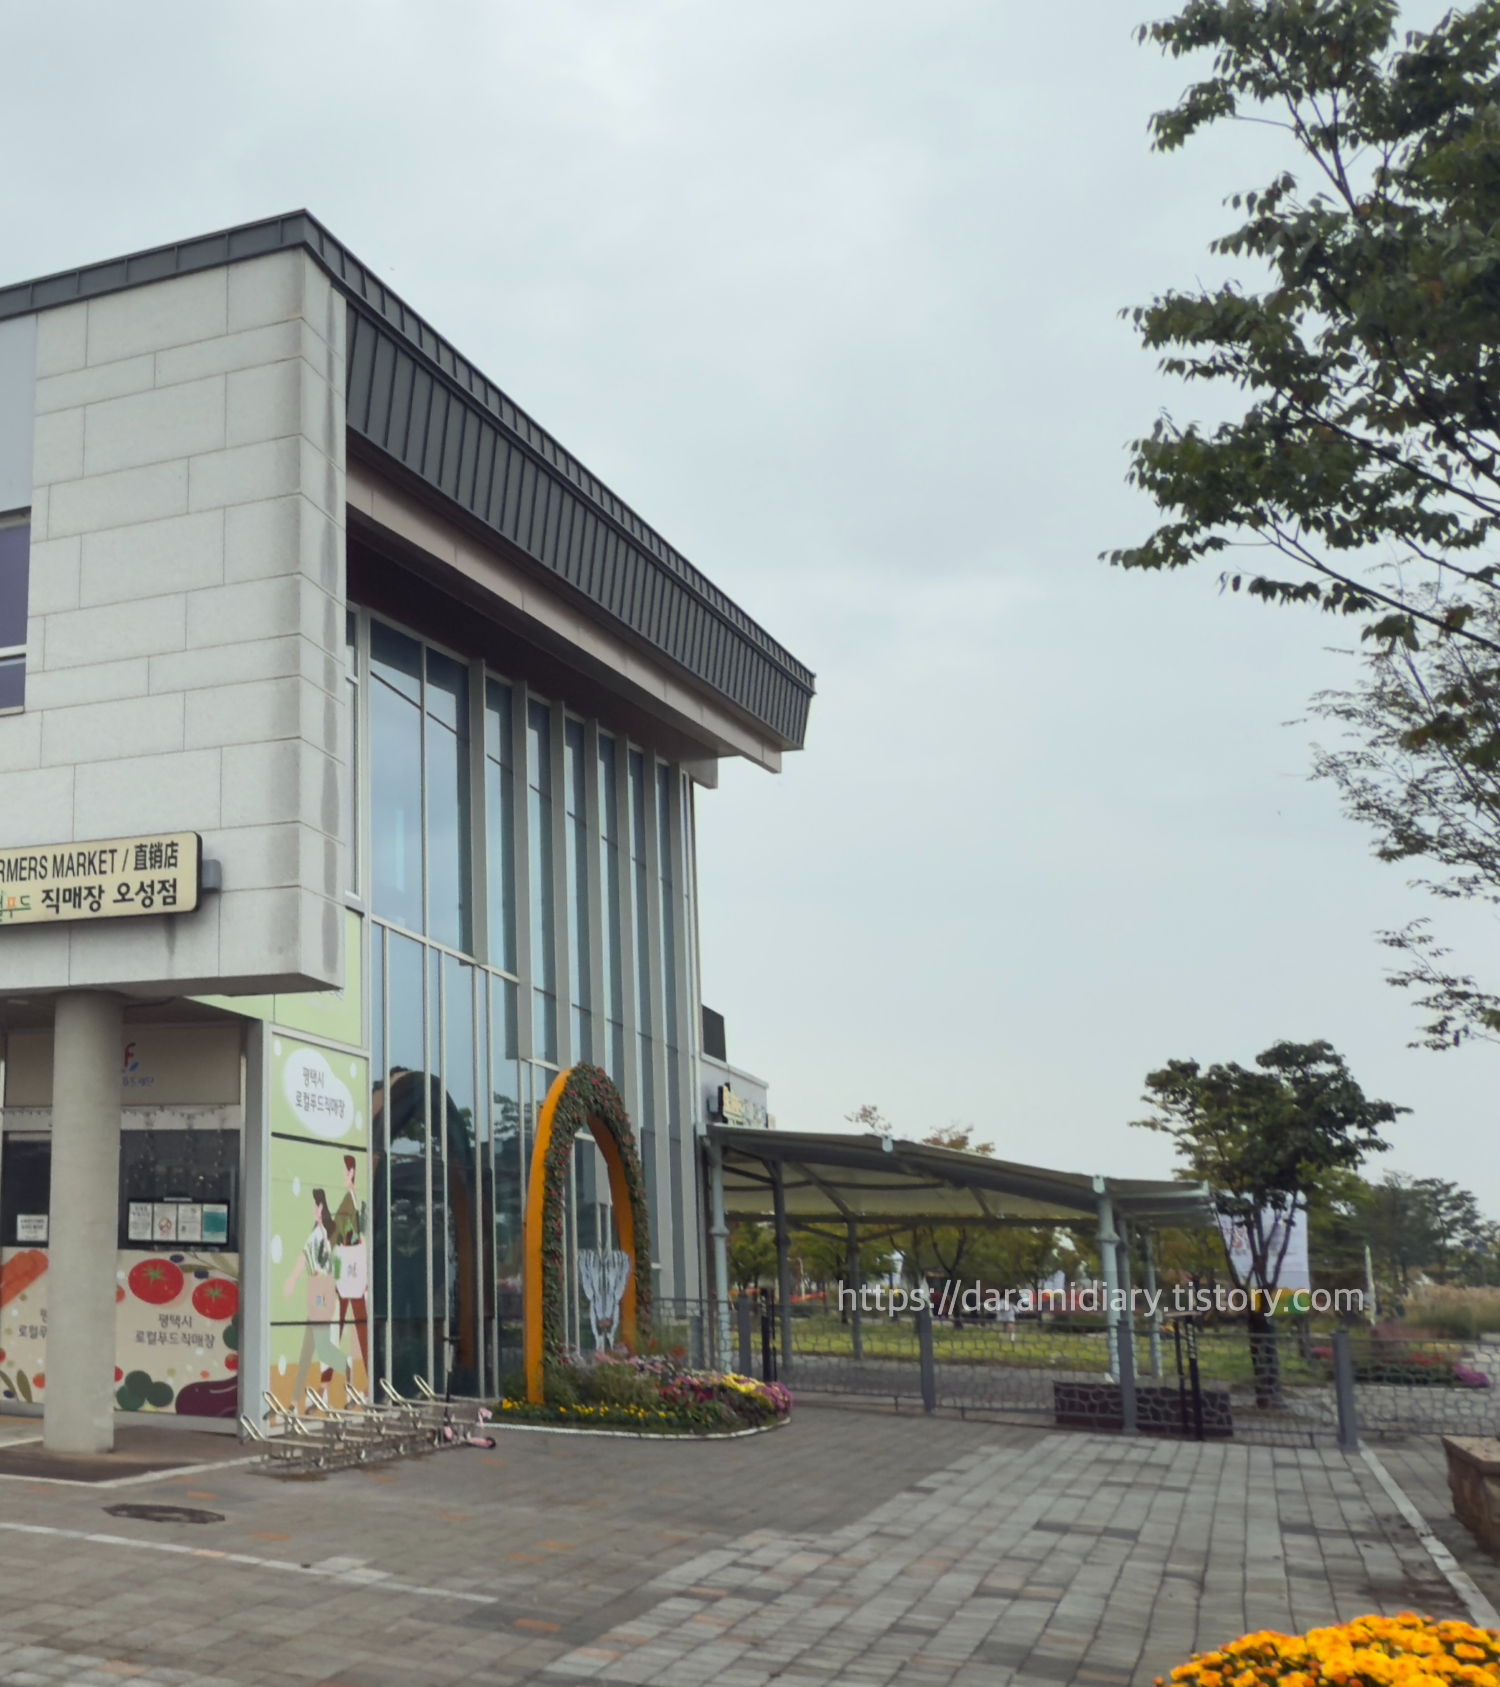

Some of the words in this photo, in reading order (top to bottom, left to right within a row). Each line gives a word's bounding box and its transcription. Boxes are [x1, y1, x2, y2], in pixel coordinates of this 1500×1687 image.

[52, 849, 118, 879] MARKET
[41, 884, 105, 914] 직매장
[113, 878, 178, 909] 오성점
[303, 1067, 325, 1089] 평택시
[158, 1313, 193, 1329] 평택시
